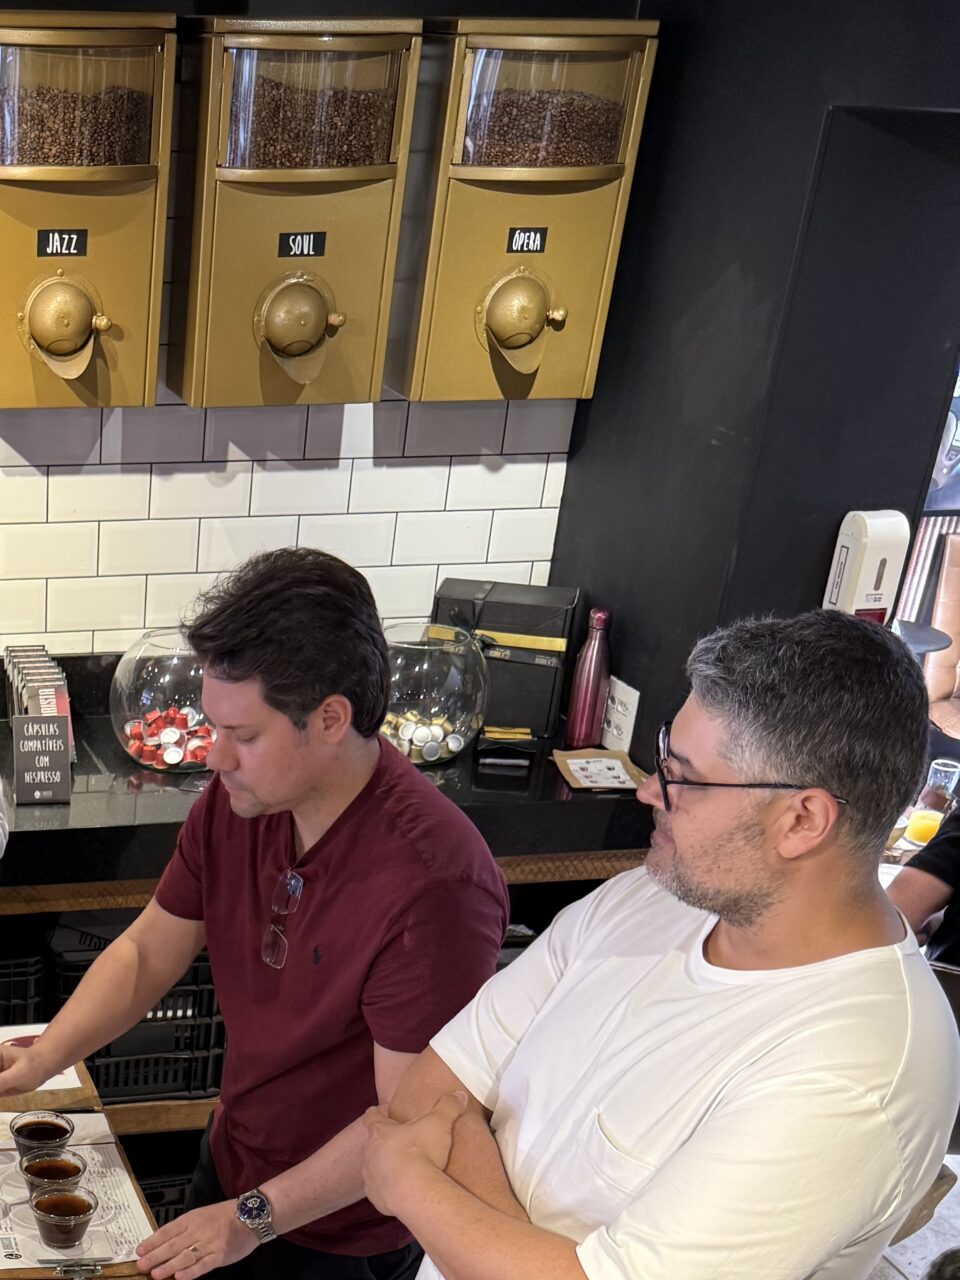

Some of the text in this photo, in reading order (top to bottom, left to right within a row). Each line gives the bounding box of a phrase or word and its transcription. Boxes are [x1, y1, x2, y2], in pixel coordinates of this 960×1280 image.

[46, 232, 77, 253] JAZZ
[289, 233, 315, 255] SOUL
[512, 229, 541, 251] ÓPERA
[24, 722, 59, 736] CÁPSULAS
[20, 738, 64, 752] COMPATÍVEIS
[35, 755, 50, 767] COM
[24, 770, 61, 783] NESPRESSO
